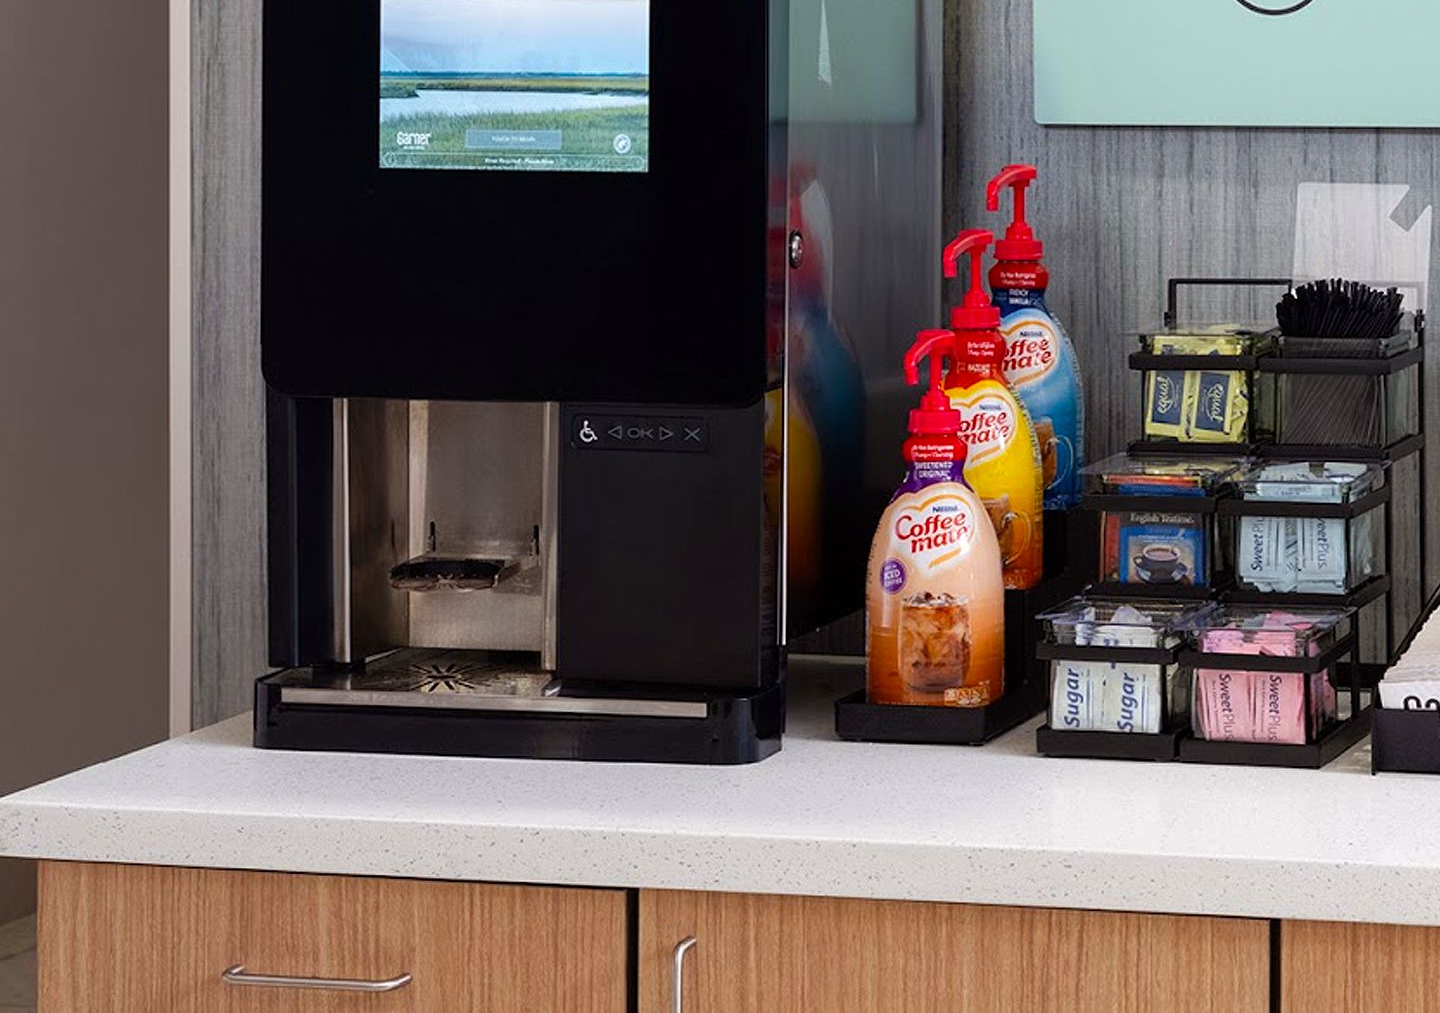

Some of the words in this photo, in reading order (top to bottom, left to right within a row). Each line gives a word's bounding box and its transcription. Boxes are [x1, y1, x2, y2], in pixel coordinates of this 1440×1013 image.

[627, 428, 654, 439] OK
[960, 412, 1007, 432] offee
[896, 512, 966, 541] Coffee
[1130, 513, 1160, 524] English
[1064, 669, 1084, 728] Sugar
[1117, 672, 1138, 733] Sugar
[1219, 673, 1236, 741] SweetPlus
[1267, 674, 1282, 741] SweetPlus
